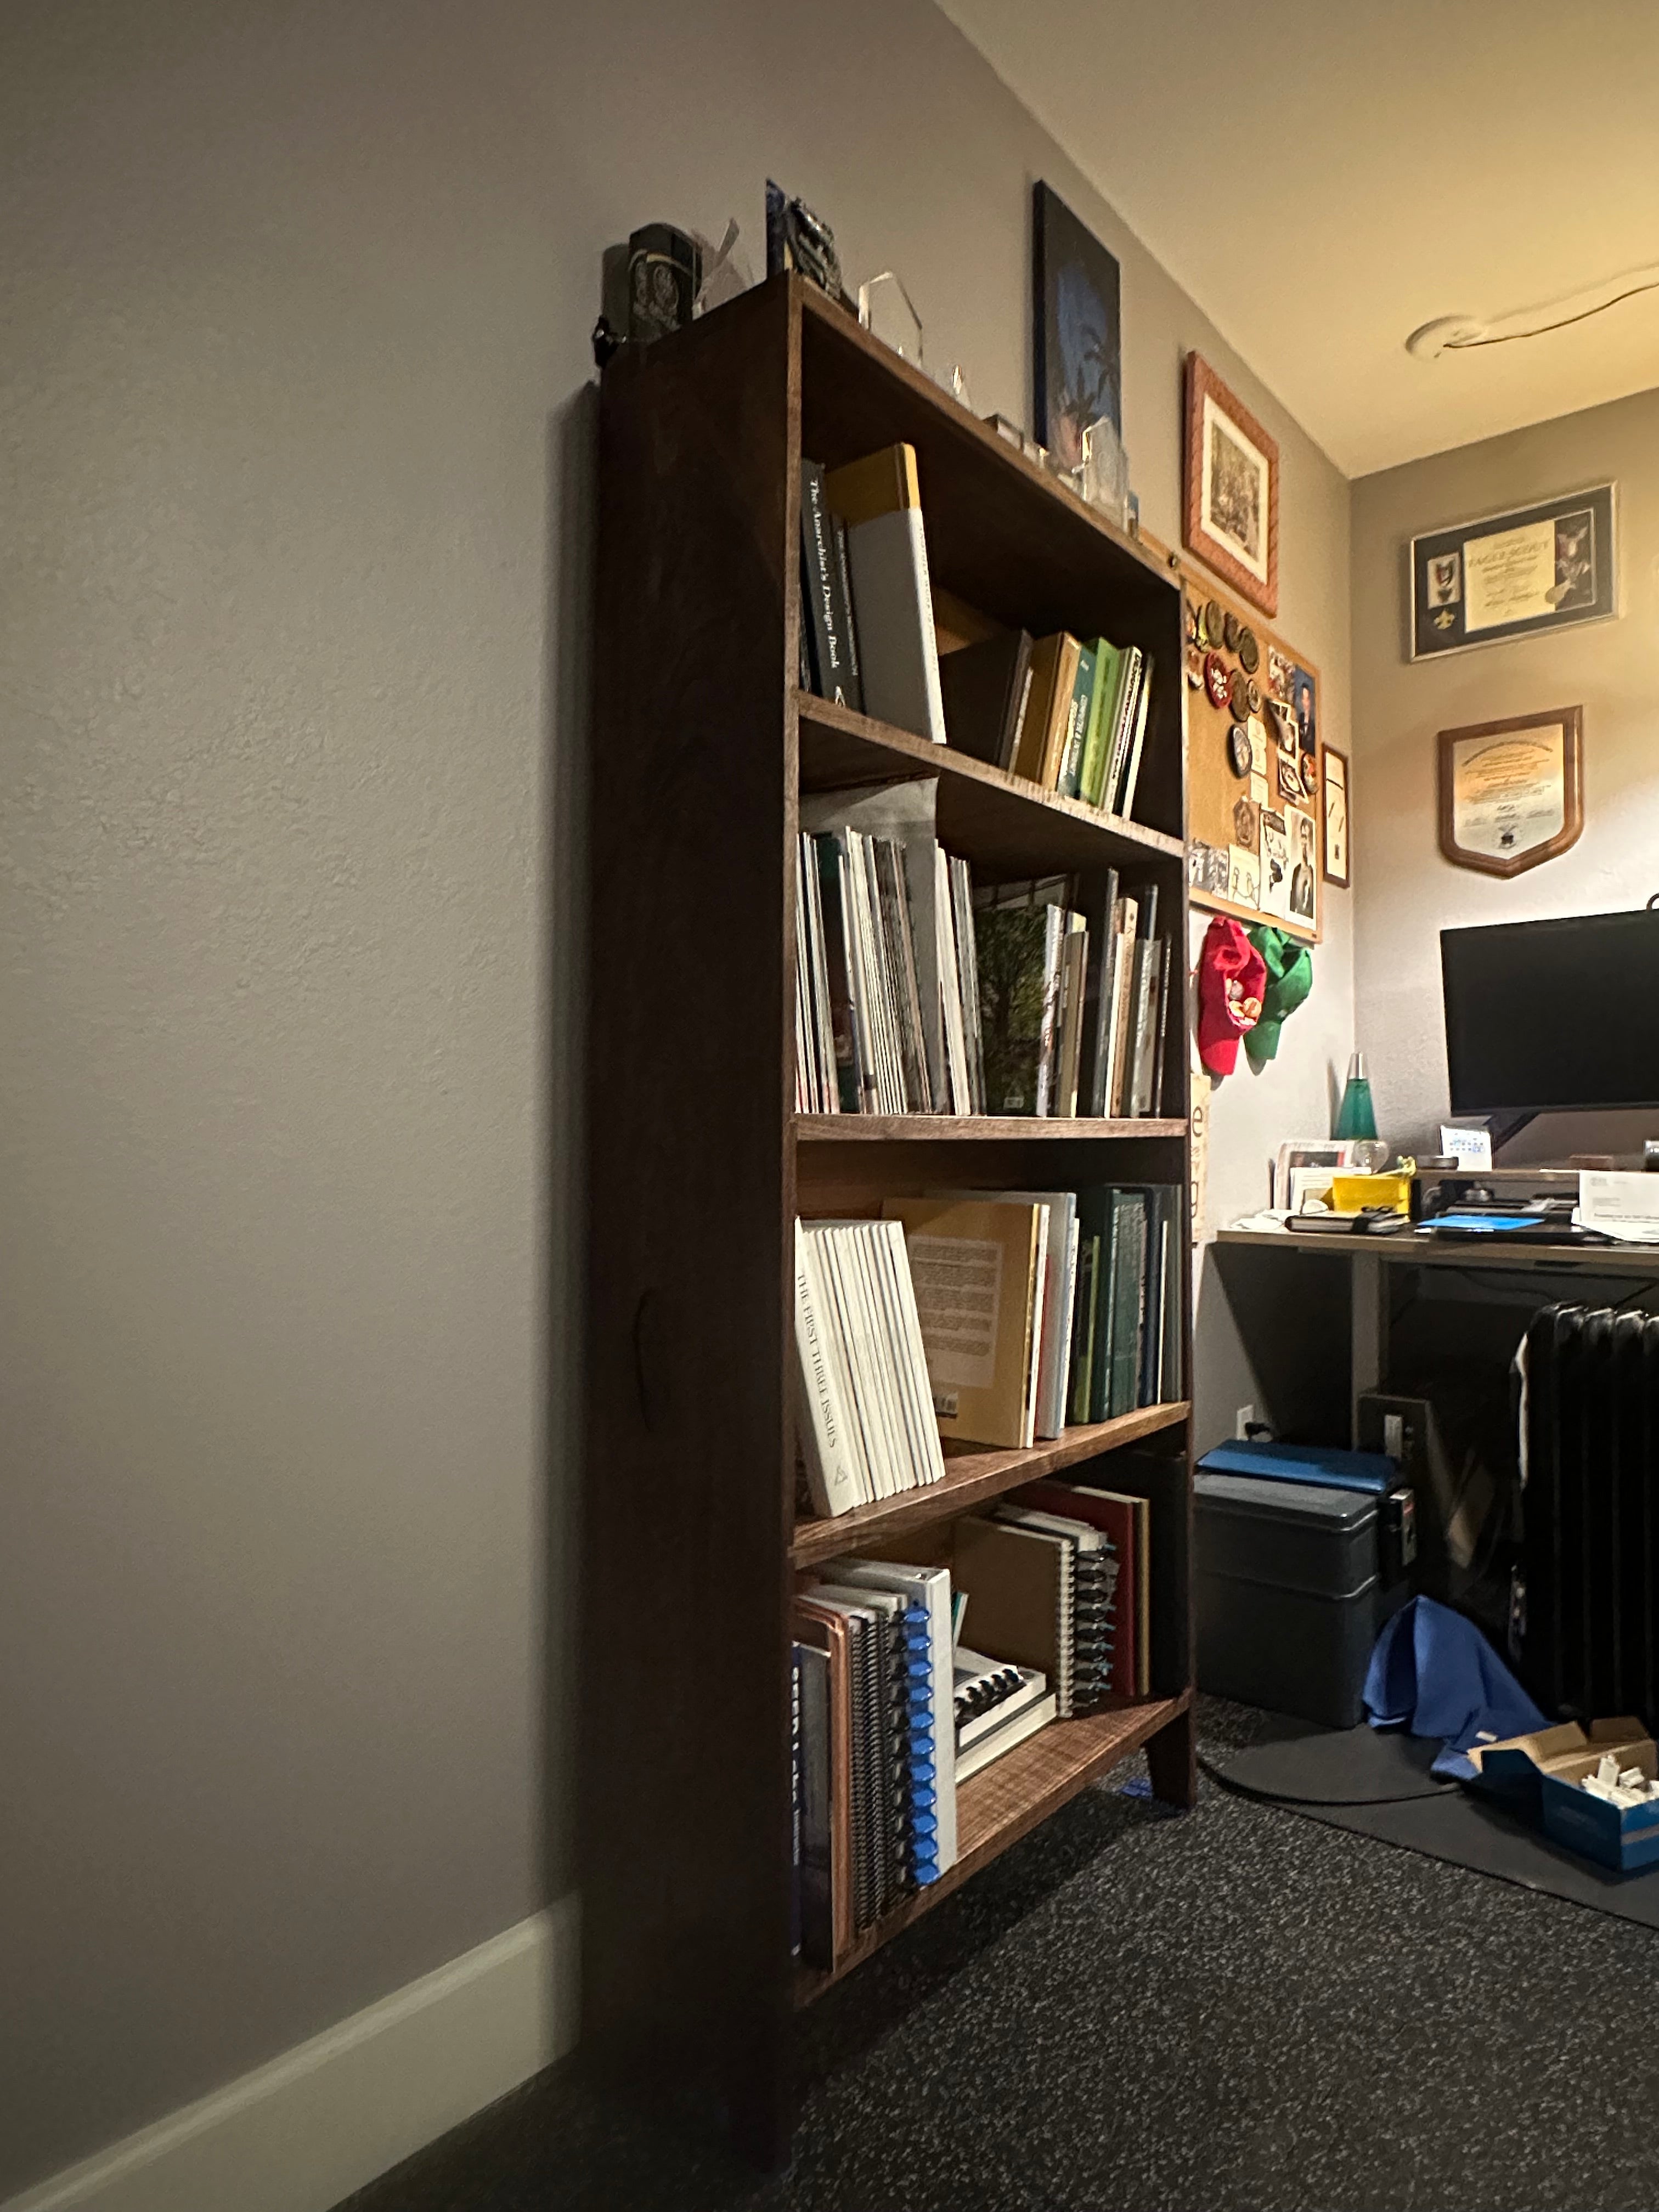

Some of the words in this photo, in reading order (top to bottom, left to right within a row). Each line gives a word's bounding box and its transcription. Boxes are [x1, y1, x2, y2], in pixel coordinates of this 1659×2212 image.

[810, 477, 819, 504] The
[823, 585, 832, 631] Design
[828, 635, 839, 669] Book
[798, 1274, 809, 1304] THE
[803, 1306, 817, 1345] FIRST
[812, 1350, 827, 1394] THREE
[821, 1398, 836, 1448] ISSUES
